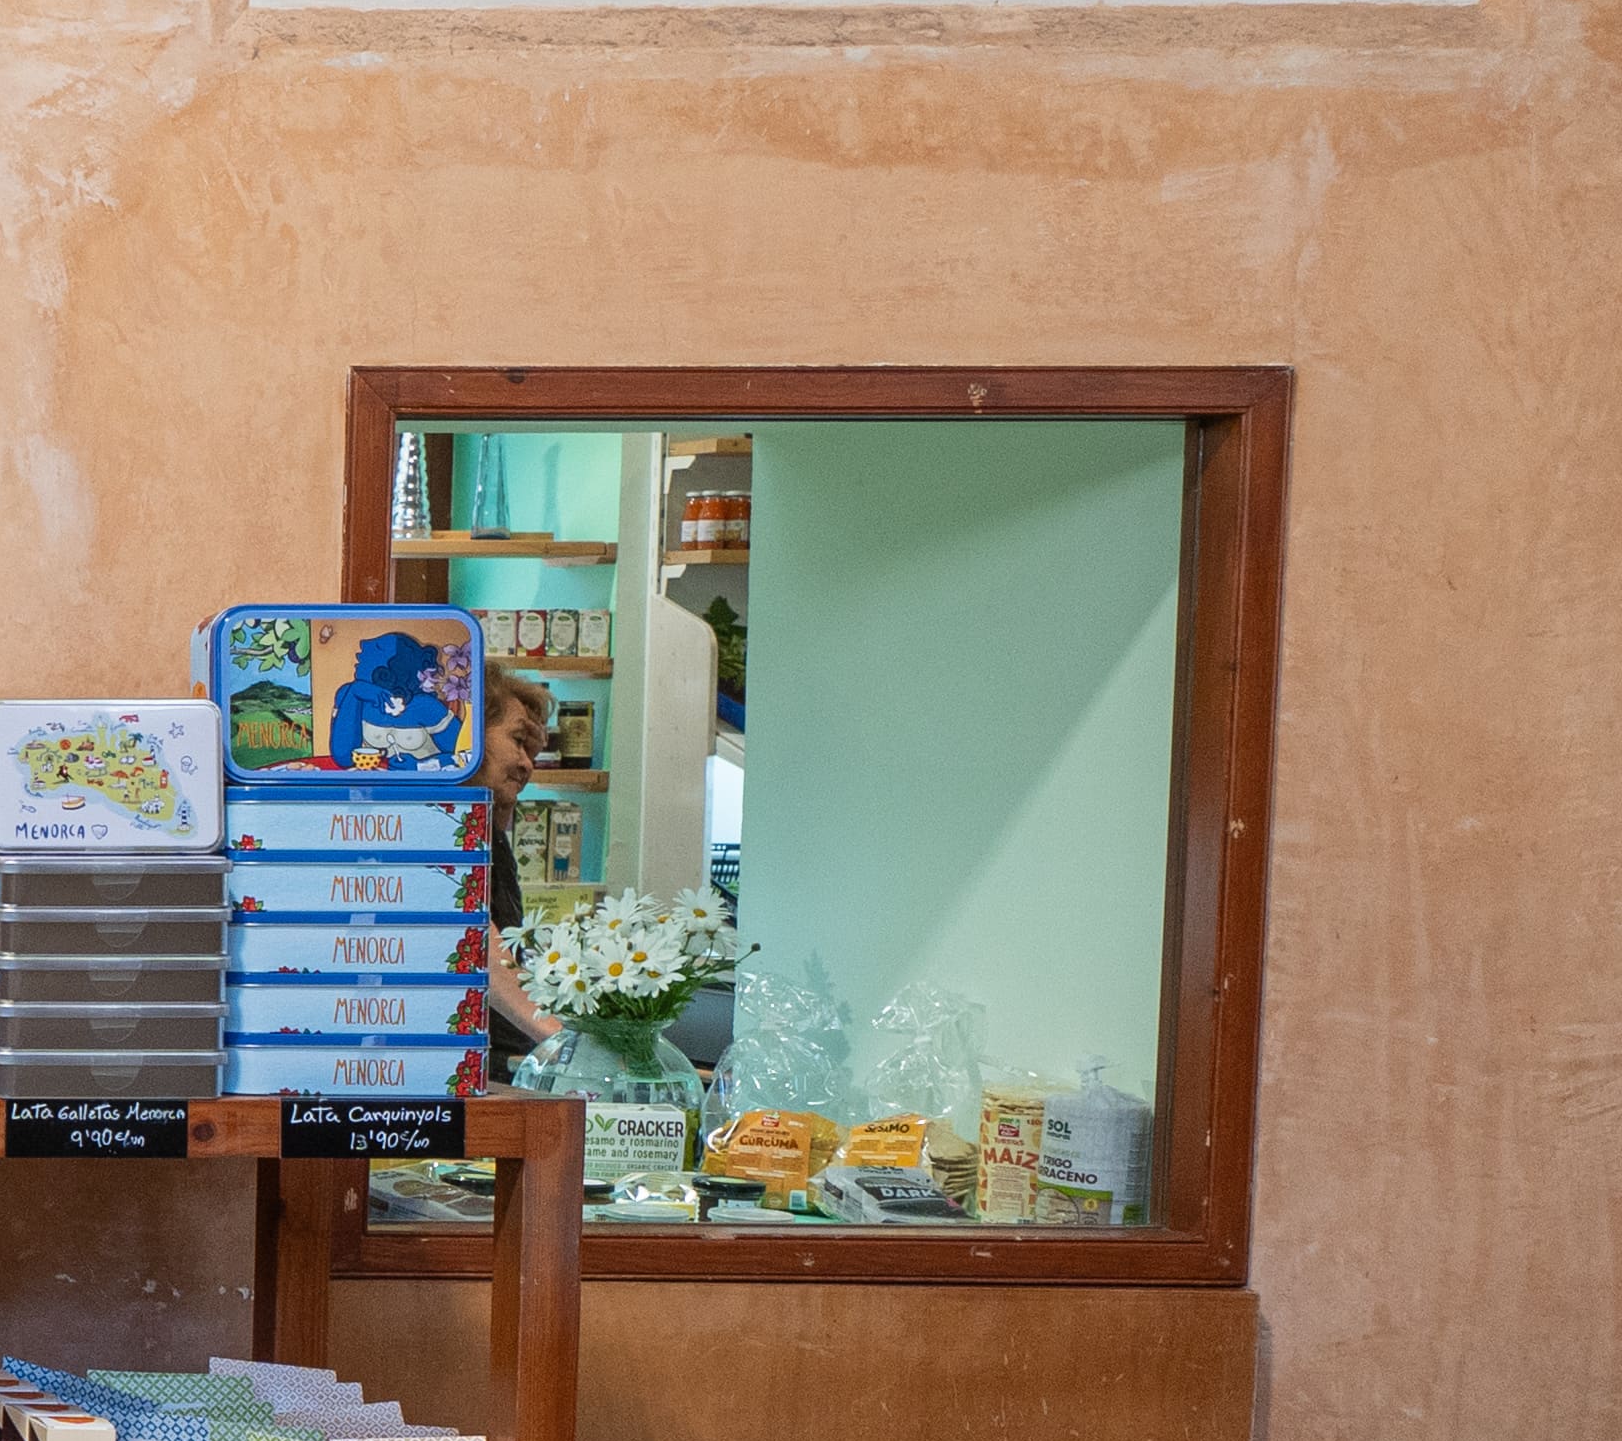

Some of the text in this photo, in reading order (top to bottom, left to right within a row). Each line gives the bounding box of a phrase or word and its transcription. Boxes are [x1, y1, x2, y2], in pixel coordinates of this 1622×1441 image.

[238, 721, 310, 750] MENORCA
[15, 823, 85, 839] MENORCA
[330, 814, 403, 842] MENORCA
[331, 875, 404, 903] MENORCA
[333, 937, 405, 964] MENORCA
[334, 998, 406, 1025] MENORCA
[333, 1059, 405, 1087] MENORCA
[618, 1120, 684, 1137] CRACKER
[1047, 1119, 1072, 1134] SOL
[630, 1138, 679, 1148] rosmarino
[611, 1147, 629, 1158] and
[633, 1150, 679, 1162] rosemary
[878, 1186, 936, 1200] DARK
